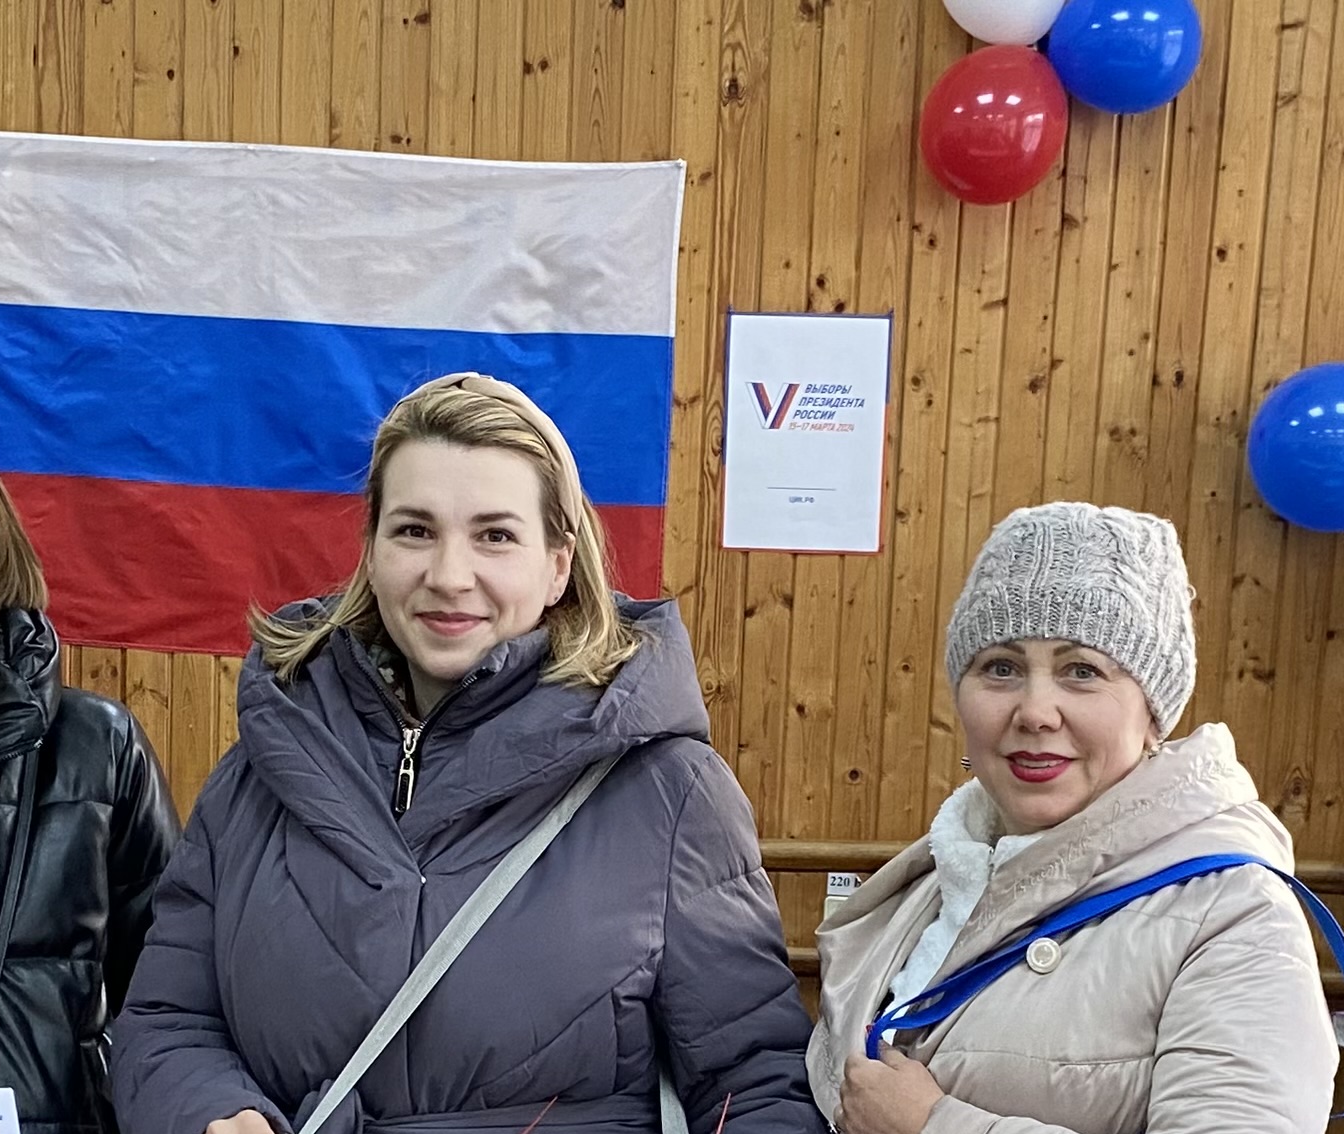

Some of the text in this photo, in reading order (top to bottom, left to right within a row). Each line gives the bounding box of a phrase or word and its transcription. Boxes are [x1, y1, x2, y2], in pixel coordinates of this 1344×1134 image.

[805, 383, 852, 394] ВЫБОРЫ
[798, 397, 865, 408] ПРЕЗИДЕНТА
[793, 410, 836, 420] РОССИИ
[830, 876, 850, 887] 220
